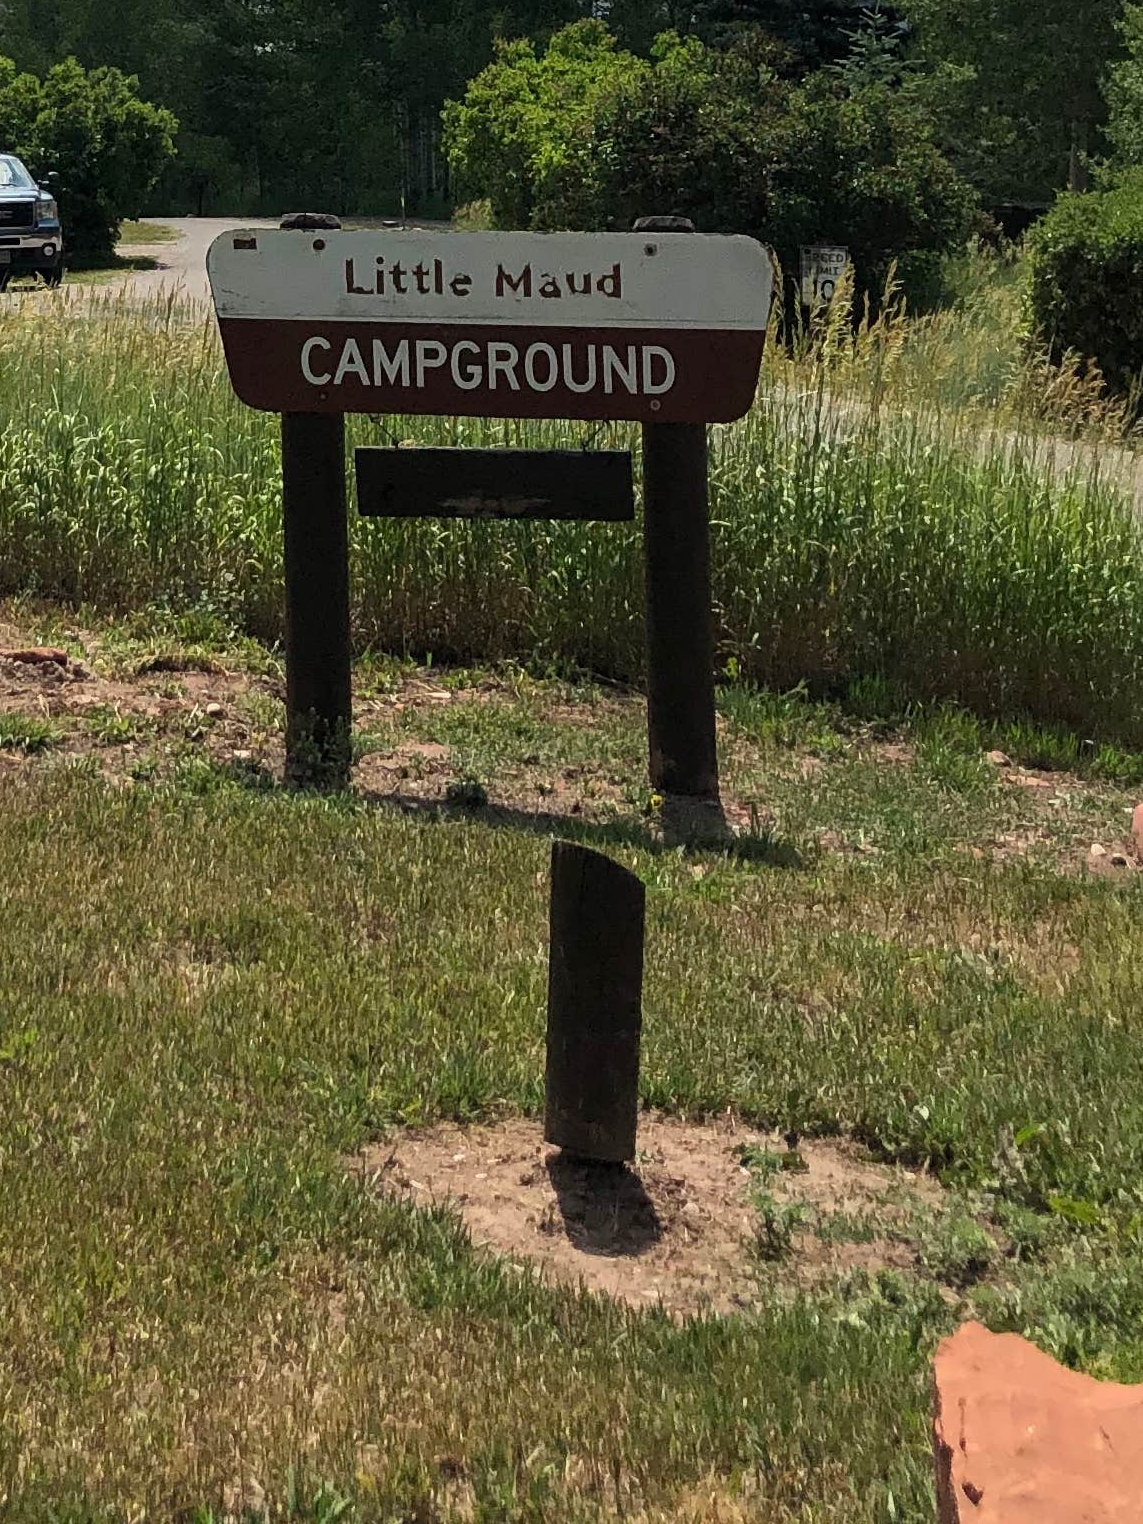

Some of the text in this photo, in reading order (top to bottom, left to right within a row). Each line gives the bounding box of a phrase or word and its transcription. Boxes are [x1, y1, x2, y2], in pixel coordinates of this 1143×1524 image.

[345, 257, 622, 299] Little Maud
[301, 336, 676, 395] CAMPGROUND
